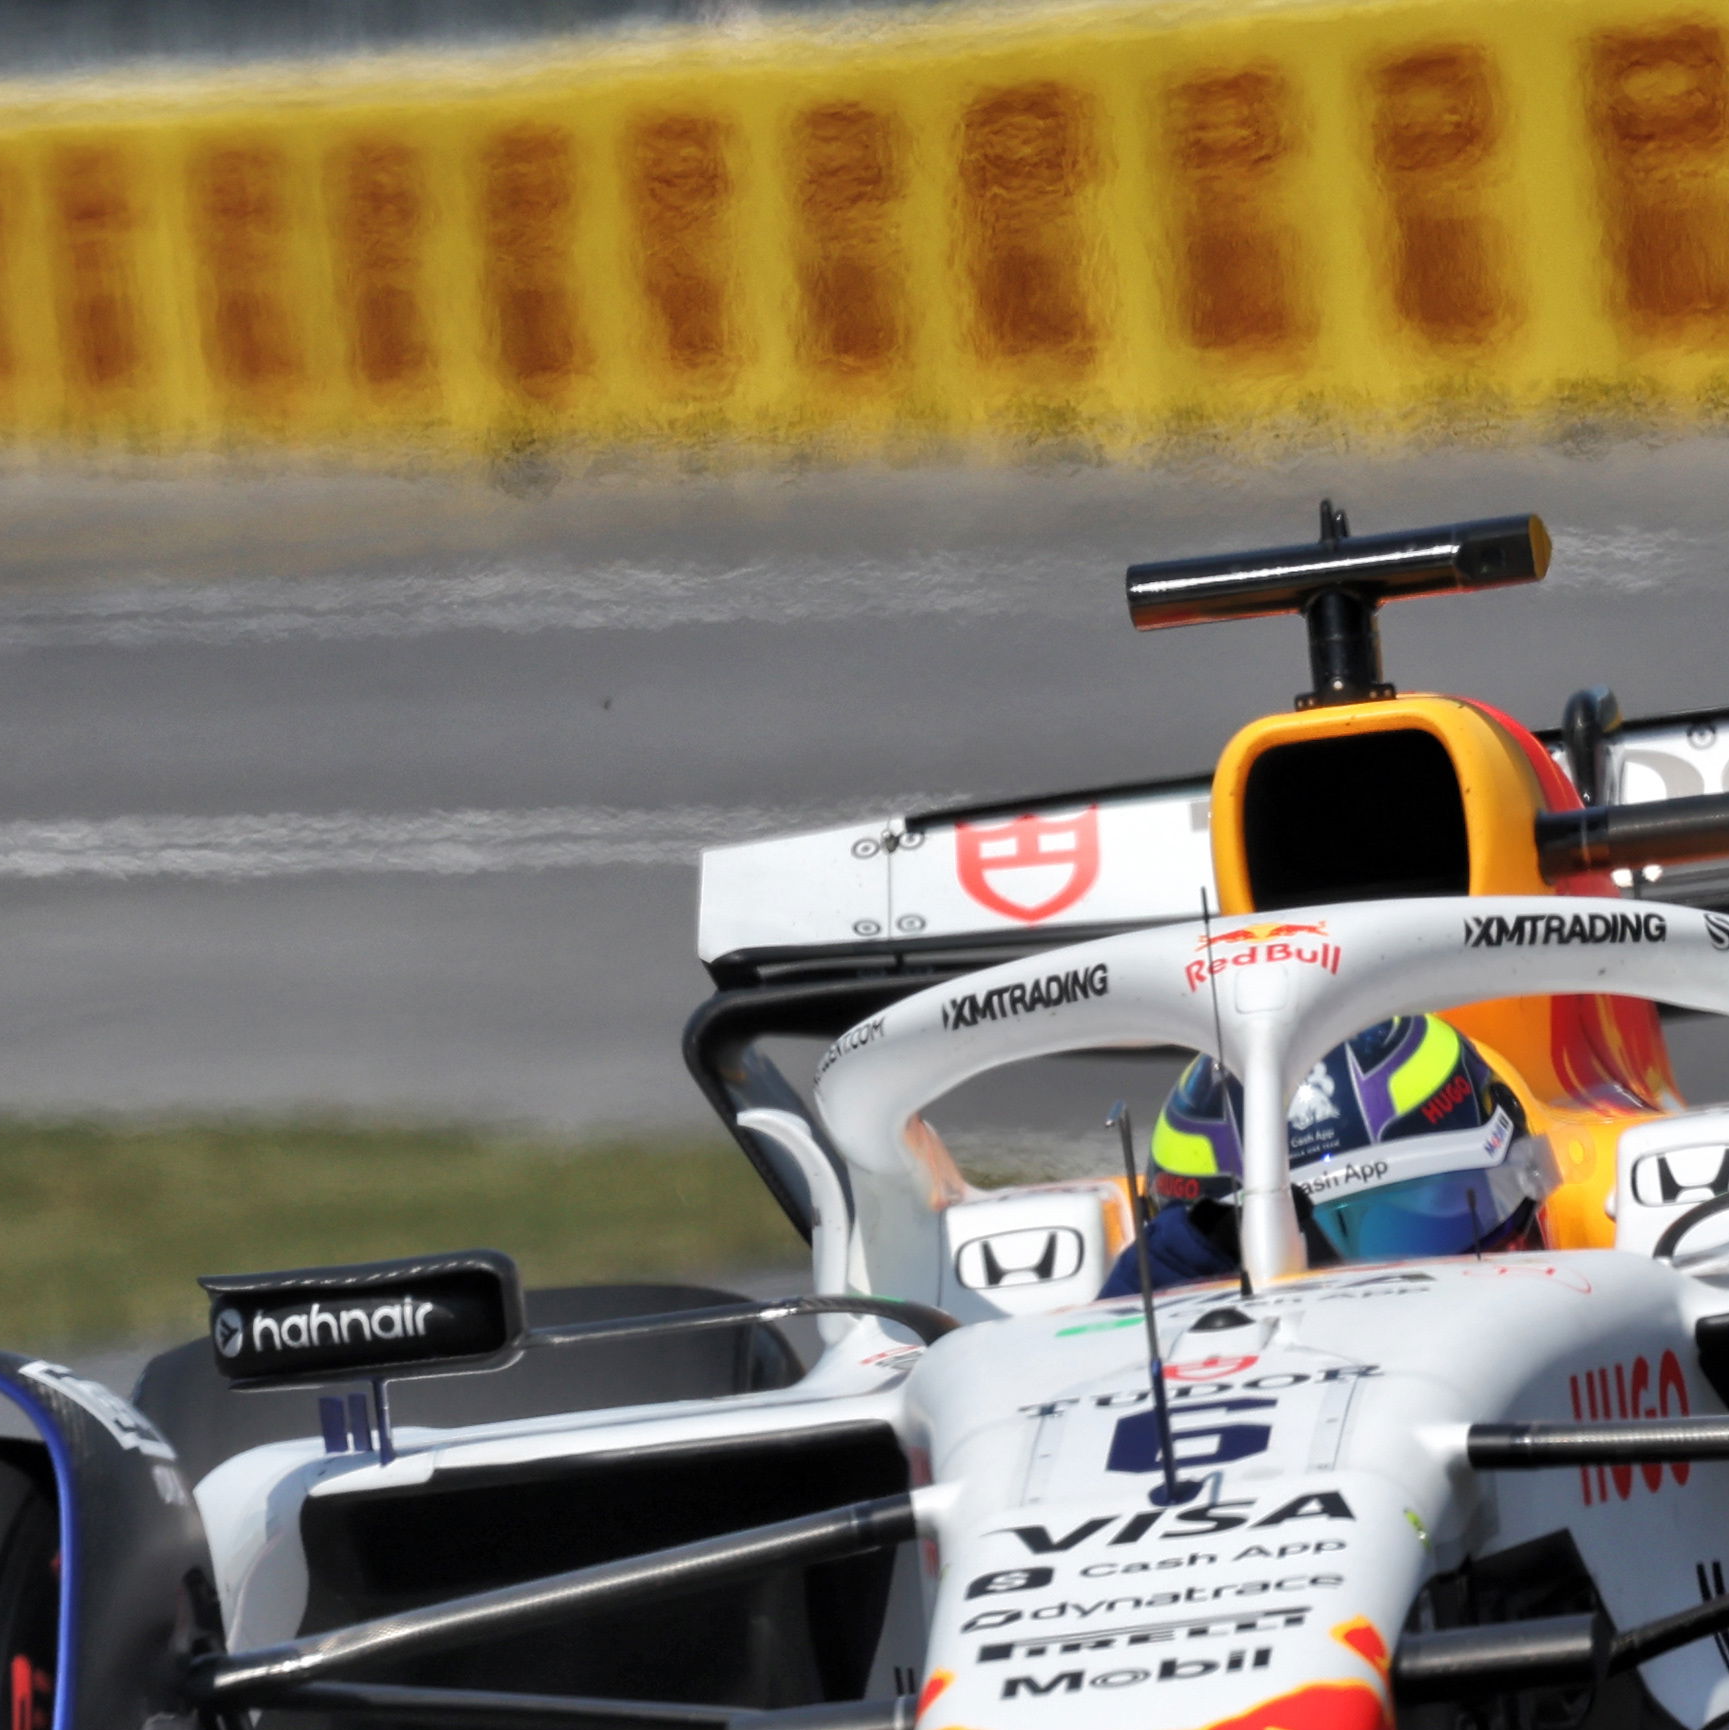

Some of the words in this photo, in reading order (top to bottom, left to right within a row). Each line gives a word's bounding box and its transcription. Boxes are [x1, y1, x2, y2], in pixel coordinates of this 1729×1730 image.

[1463, 913, 1667, 948] XMTRADING
[1185, 946, 1257, 993] Red
[1266, 943, 1341, 976] Bull
[942, 963, 1109, 1031] XMTRADING
[1421, 1075, 1472, 1124] HUGO
[1301, 1170, 1340, 1198] ash
[1343, 1158, 1389, 1185] App
[252, 1295, 434, 1352] hahnair
[1018, 1364, 1384, 1417] TUDOR
[1105, 1396, 1277, 1473] 6
[979, 1490, 1356, 1556] VISA
[1079, 1552, 1217, 1578] Cash
[1232, 1539, 1347, 1561] App
[1030, 1573, 1345, 1621] dynatrace
[976, 1606, 1313, 1665] PIRELLI
[1000, 1646, 1273, 1700] Mobil
